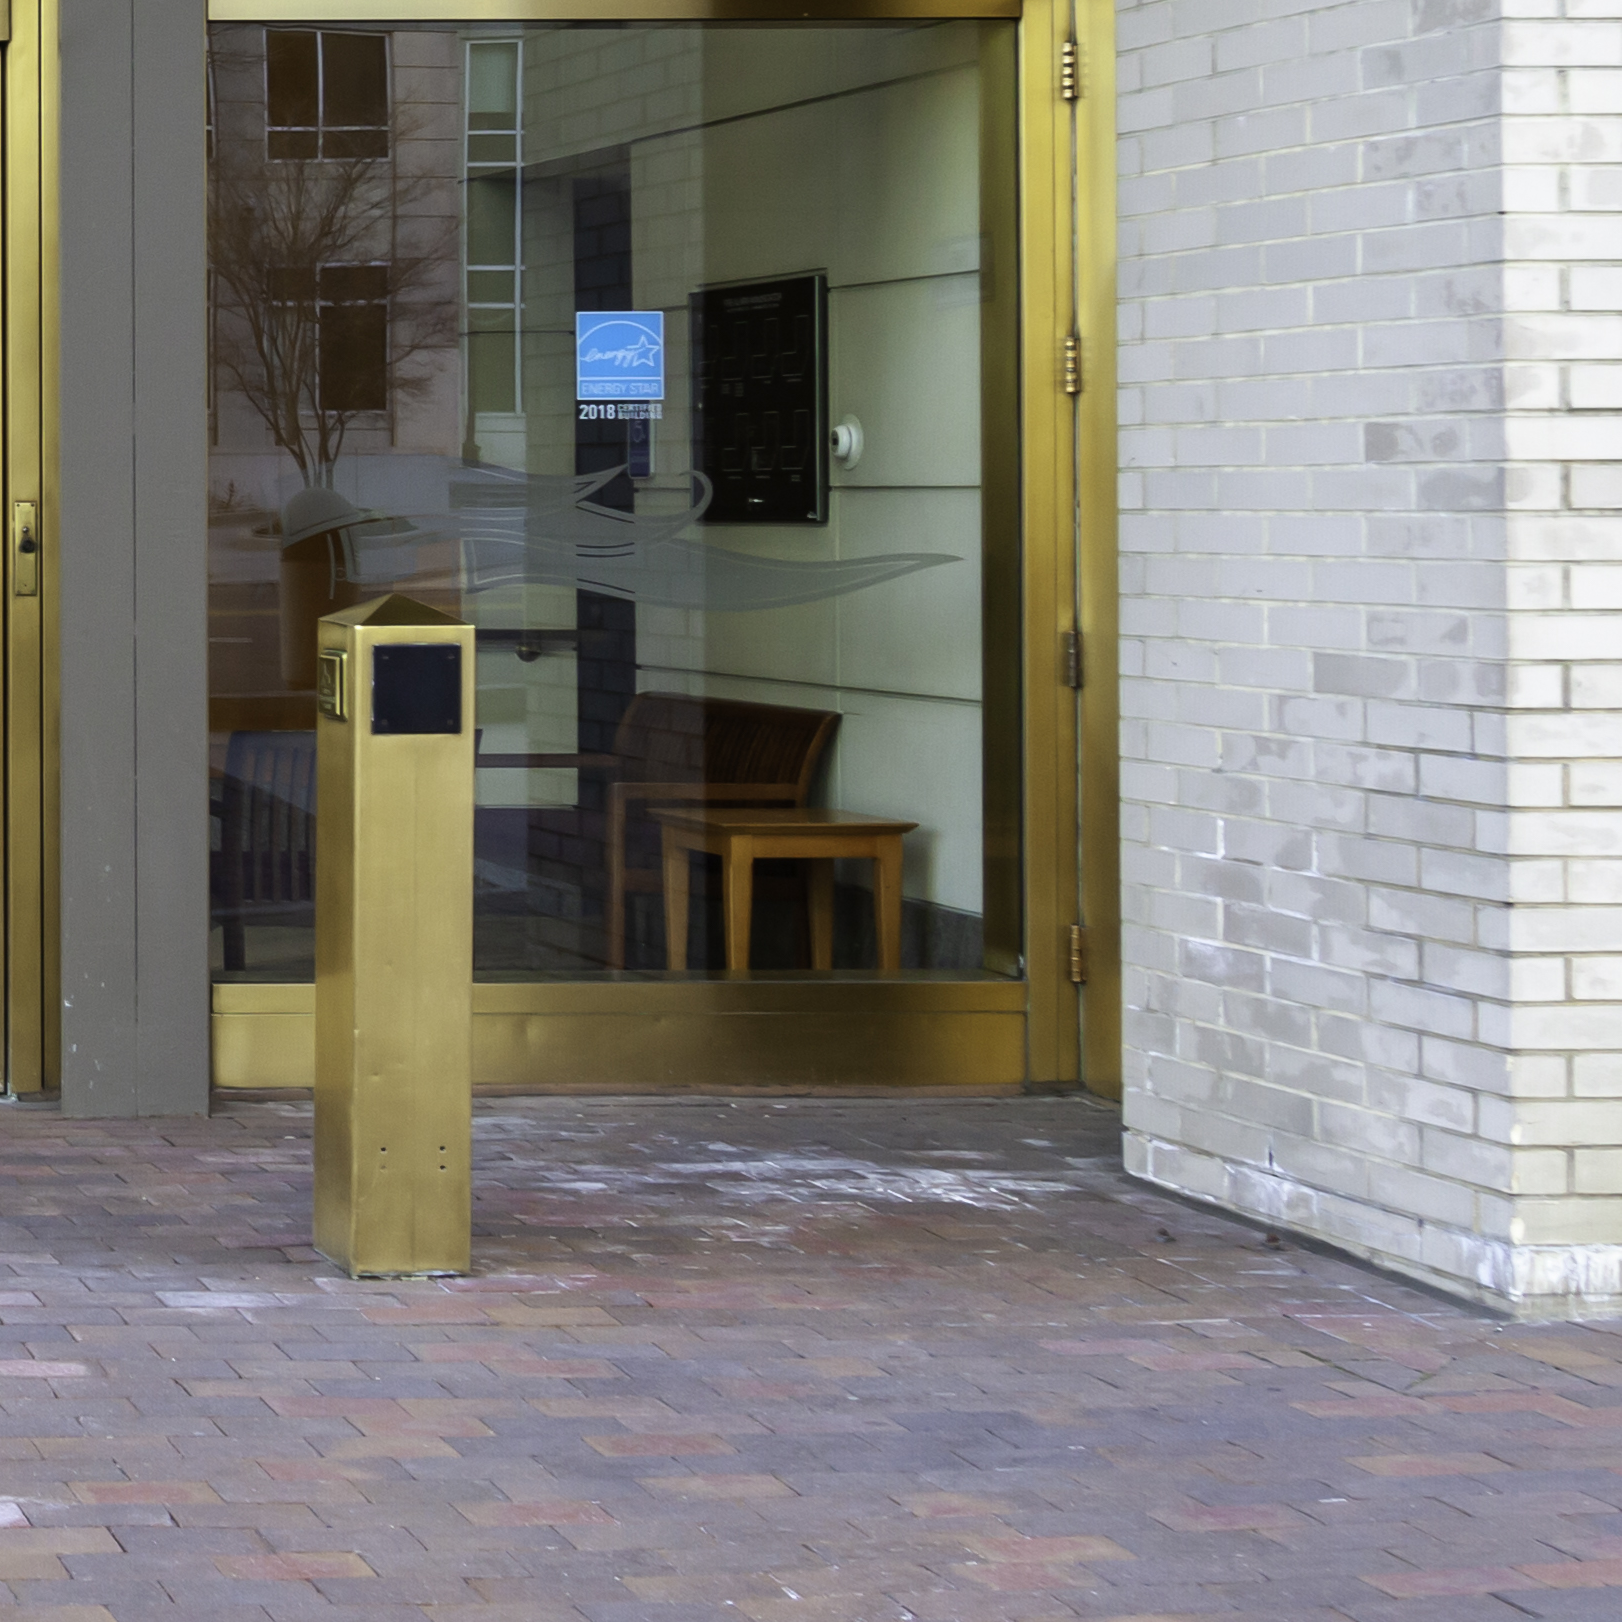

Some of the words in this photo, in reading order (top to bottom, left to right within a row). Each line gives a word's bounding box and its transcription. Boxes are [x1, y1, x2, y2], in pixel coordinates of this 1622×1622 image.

[582, 382, 626, 395] ENERGY
[629, 382, 659, 395] STAR
[579, 404, 616, 420] 2018
